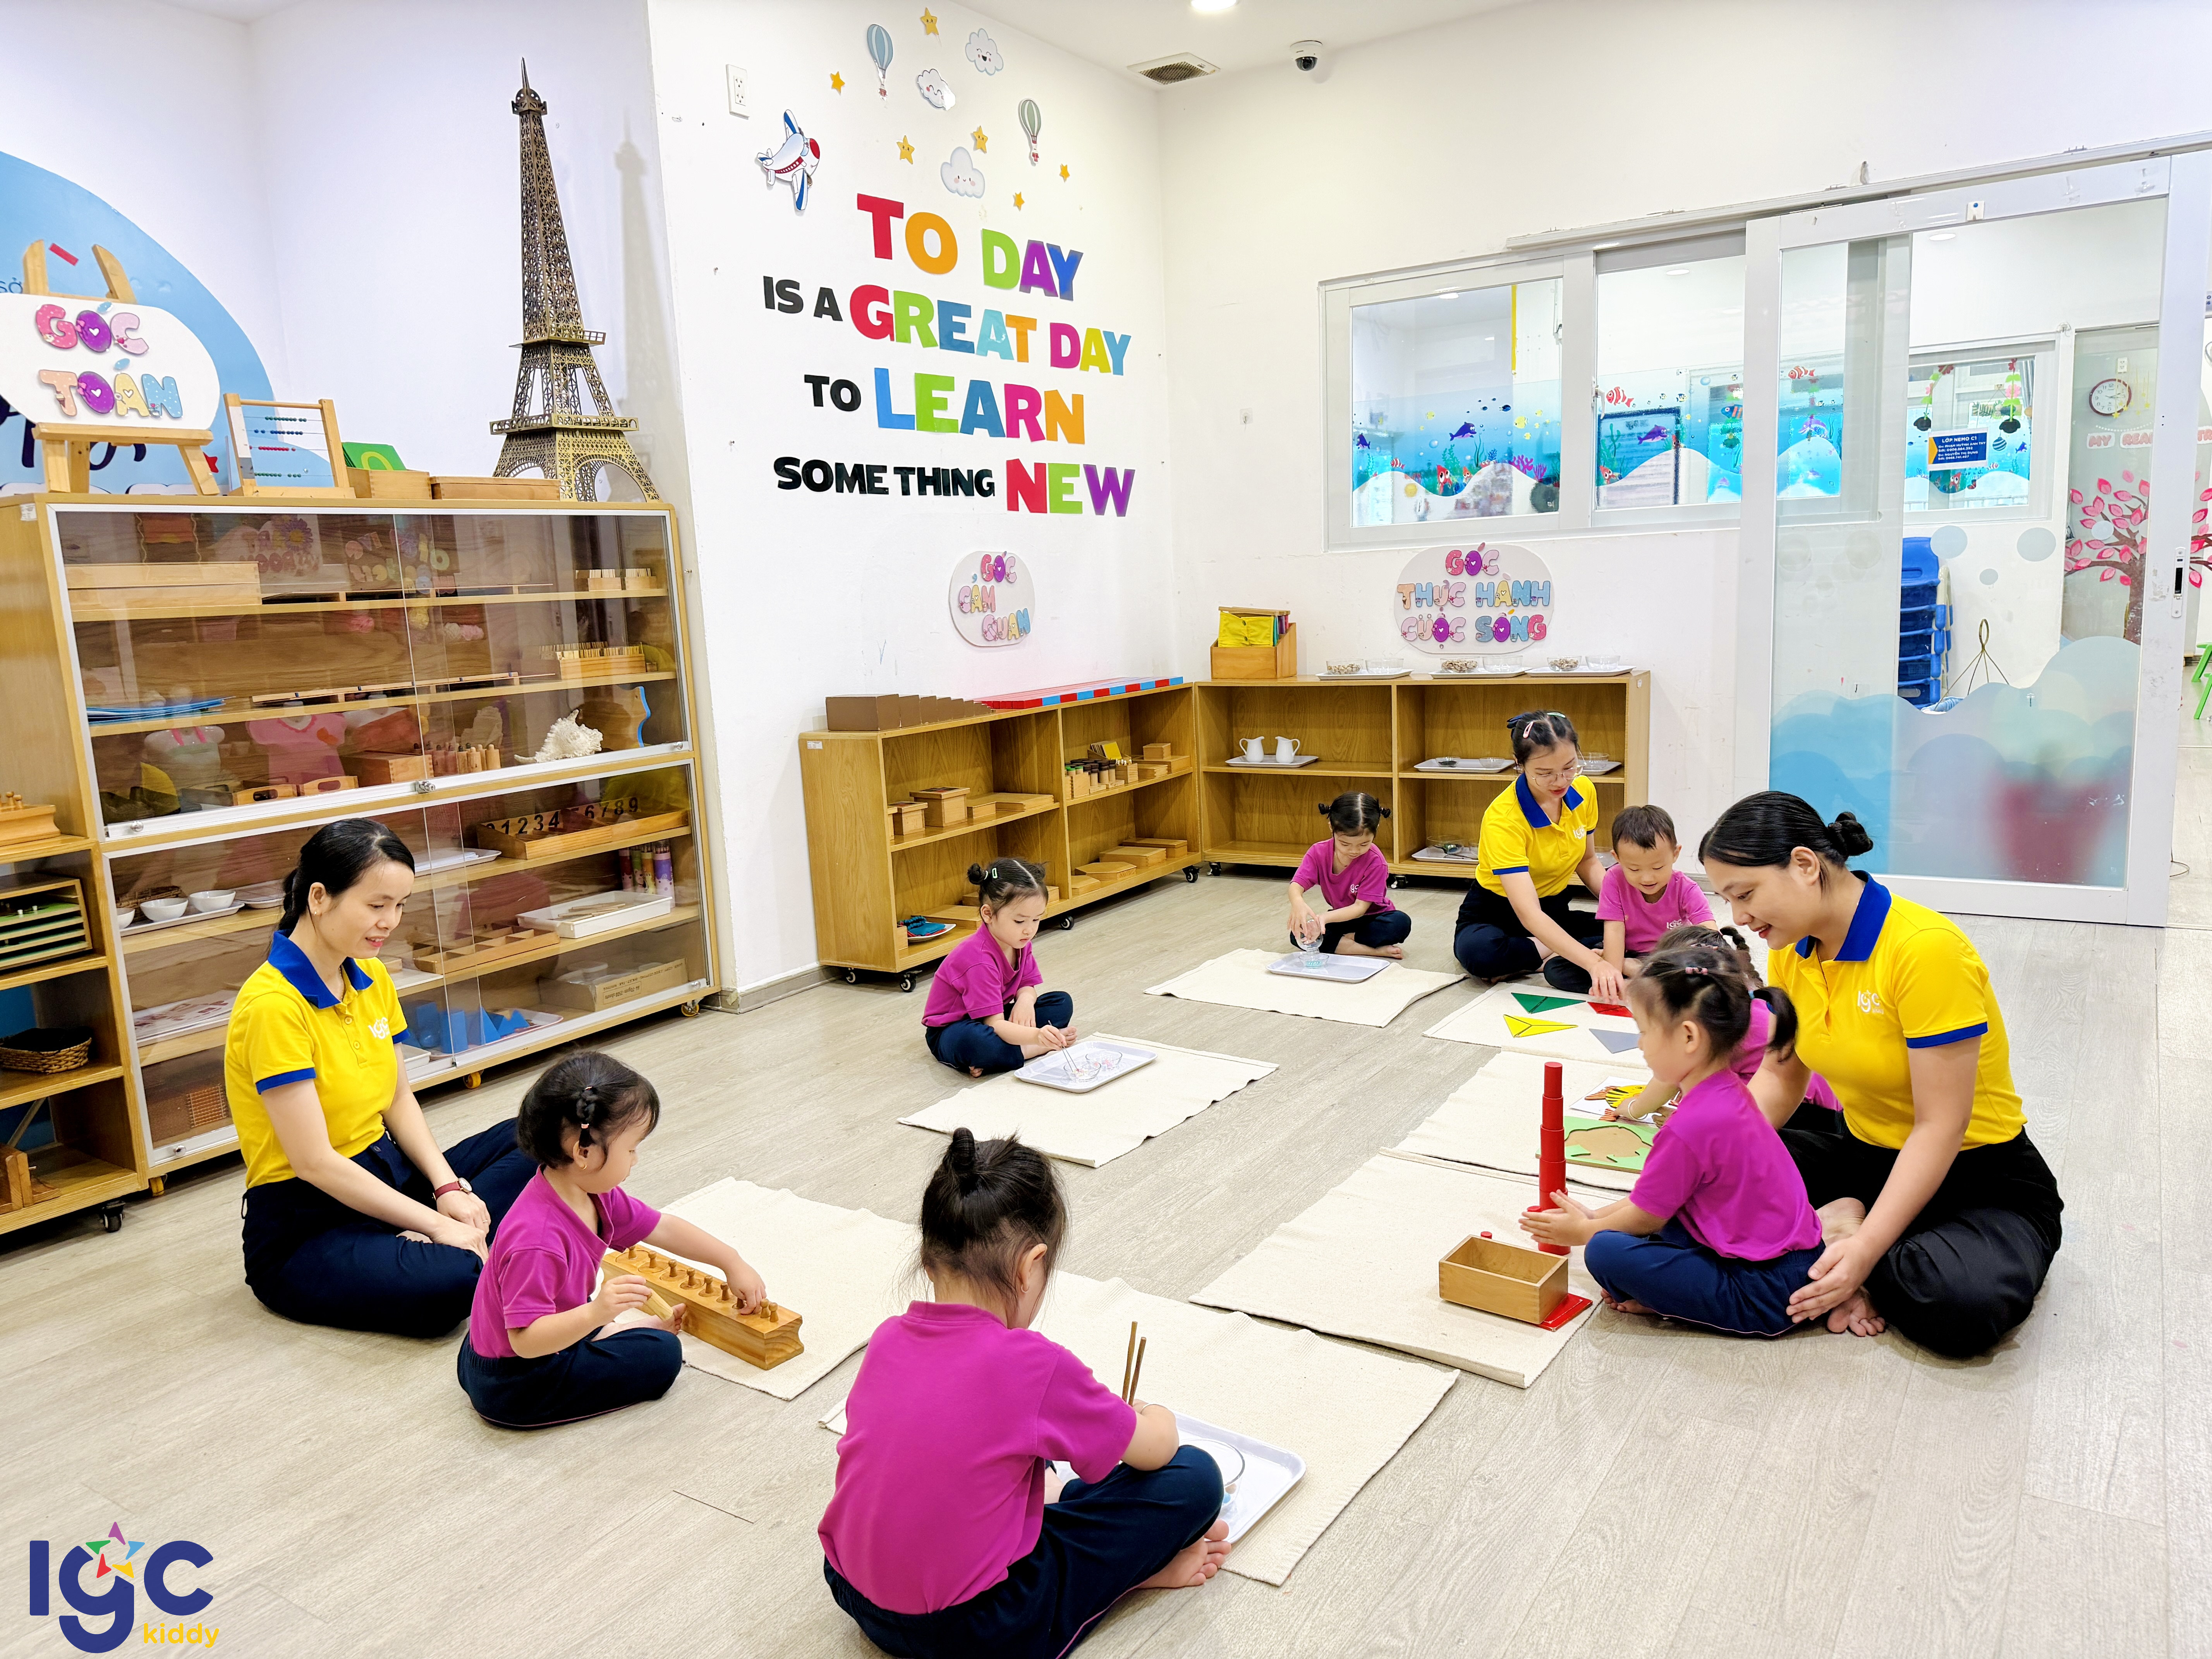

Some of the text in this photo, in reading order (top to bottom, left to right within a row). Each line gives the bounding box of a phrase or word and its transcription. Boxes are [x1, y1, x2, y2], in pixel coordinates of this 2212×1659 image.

[857, 193, 1084, 301] TO DAY
[36, 301, 149, 354] GÓC
[763, 276, 1132, 376] IS A GREAT DAY
[39, 358, 183, 418] TOÁN
[804, 367, 1085, 444] TO LEARN
[2088, 434, 2112, 447] MY
[1006, 458, 1135, 517] NEW
[981, 551, 1017, 583] GÓC
[1445, 542, 1499, 576] GÓC
[1475, 573, 1551, 608] HÀNH
[982, 608, 1031, 641] QUAN
[1475, 608, 1547, 642] SỐNG
[517, 817, 528, 834] 2
[533, 814, 544, 831] 3
[548, 811, 560, 828] 4
